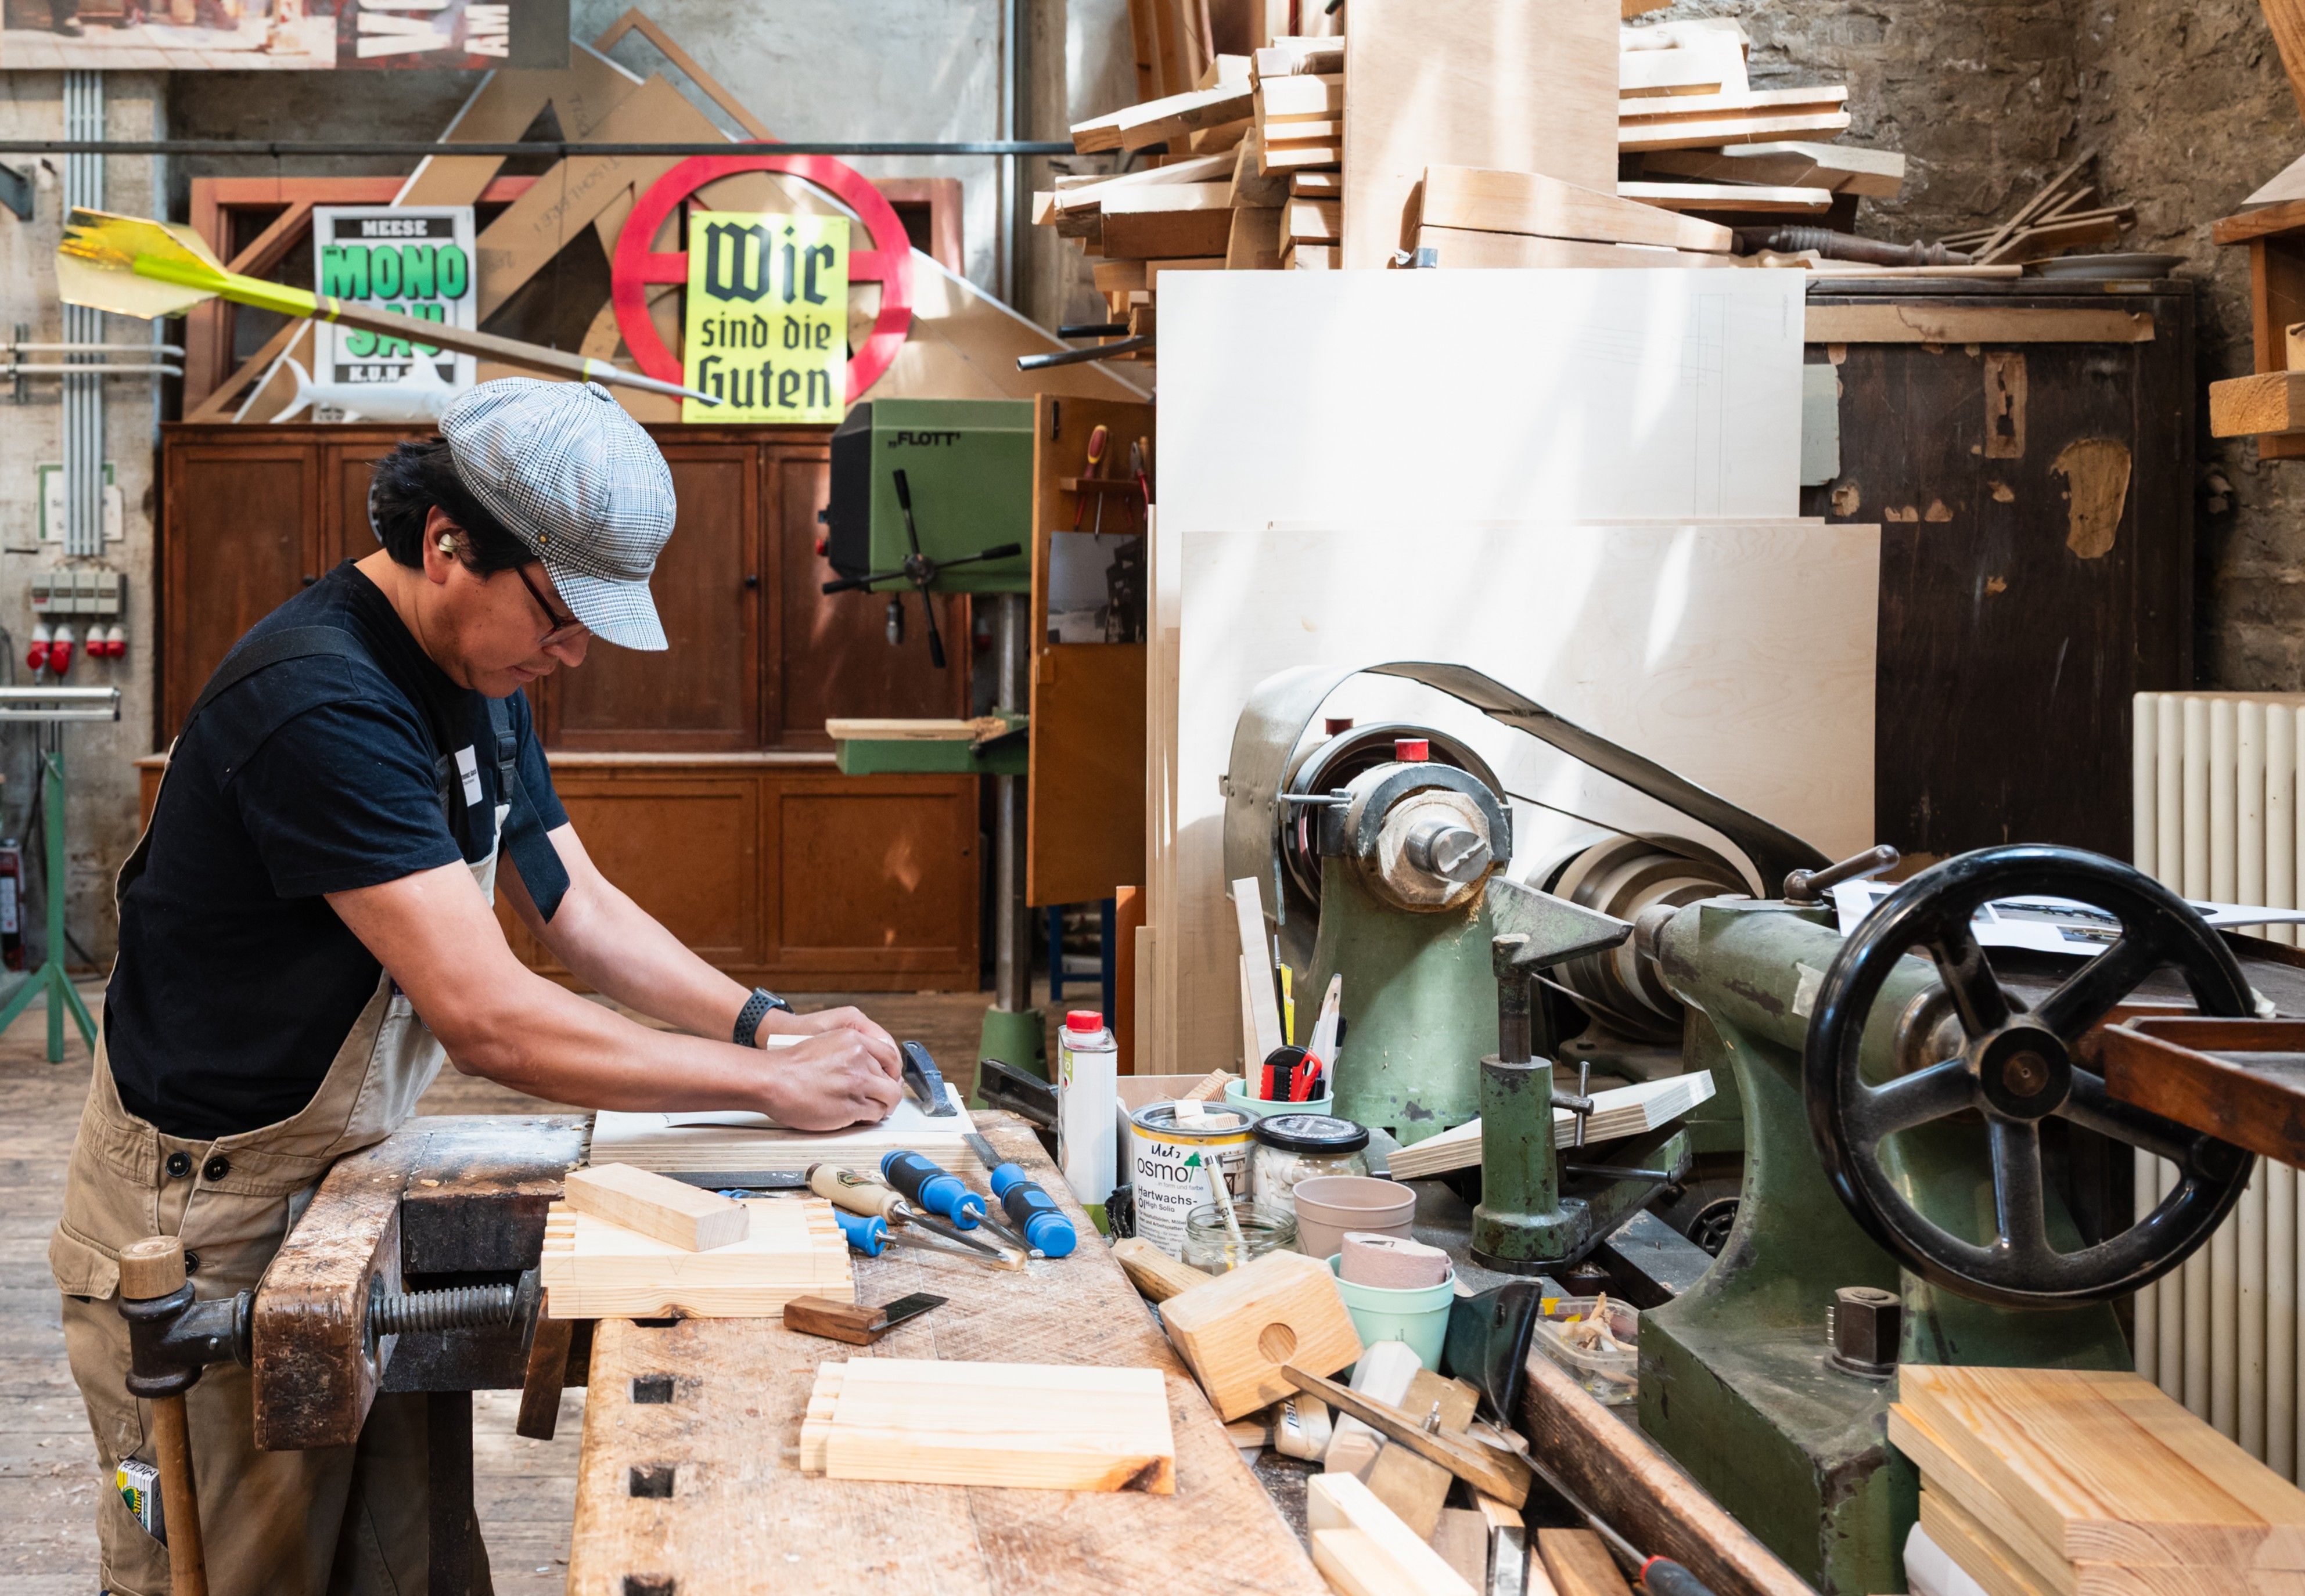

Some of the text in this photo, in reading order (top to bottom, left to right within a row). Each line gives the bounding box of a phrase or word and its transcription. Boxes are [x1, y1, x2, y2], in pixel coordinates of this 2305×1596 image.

[362, 221, 427, 236] MEESE
[322, 245, 468, 300] MONO
[705, 222, 835, 305] Wir
[702, 312, 831, 350] sind die
[699, 355, 832, 409] Guten
[1137, 1158, 1188, 1183] osmo
[1138, 1184, 1198, 1205] Hartwachs-
